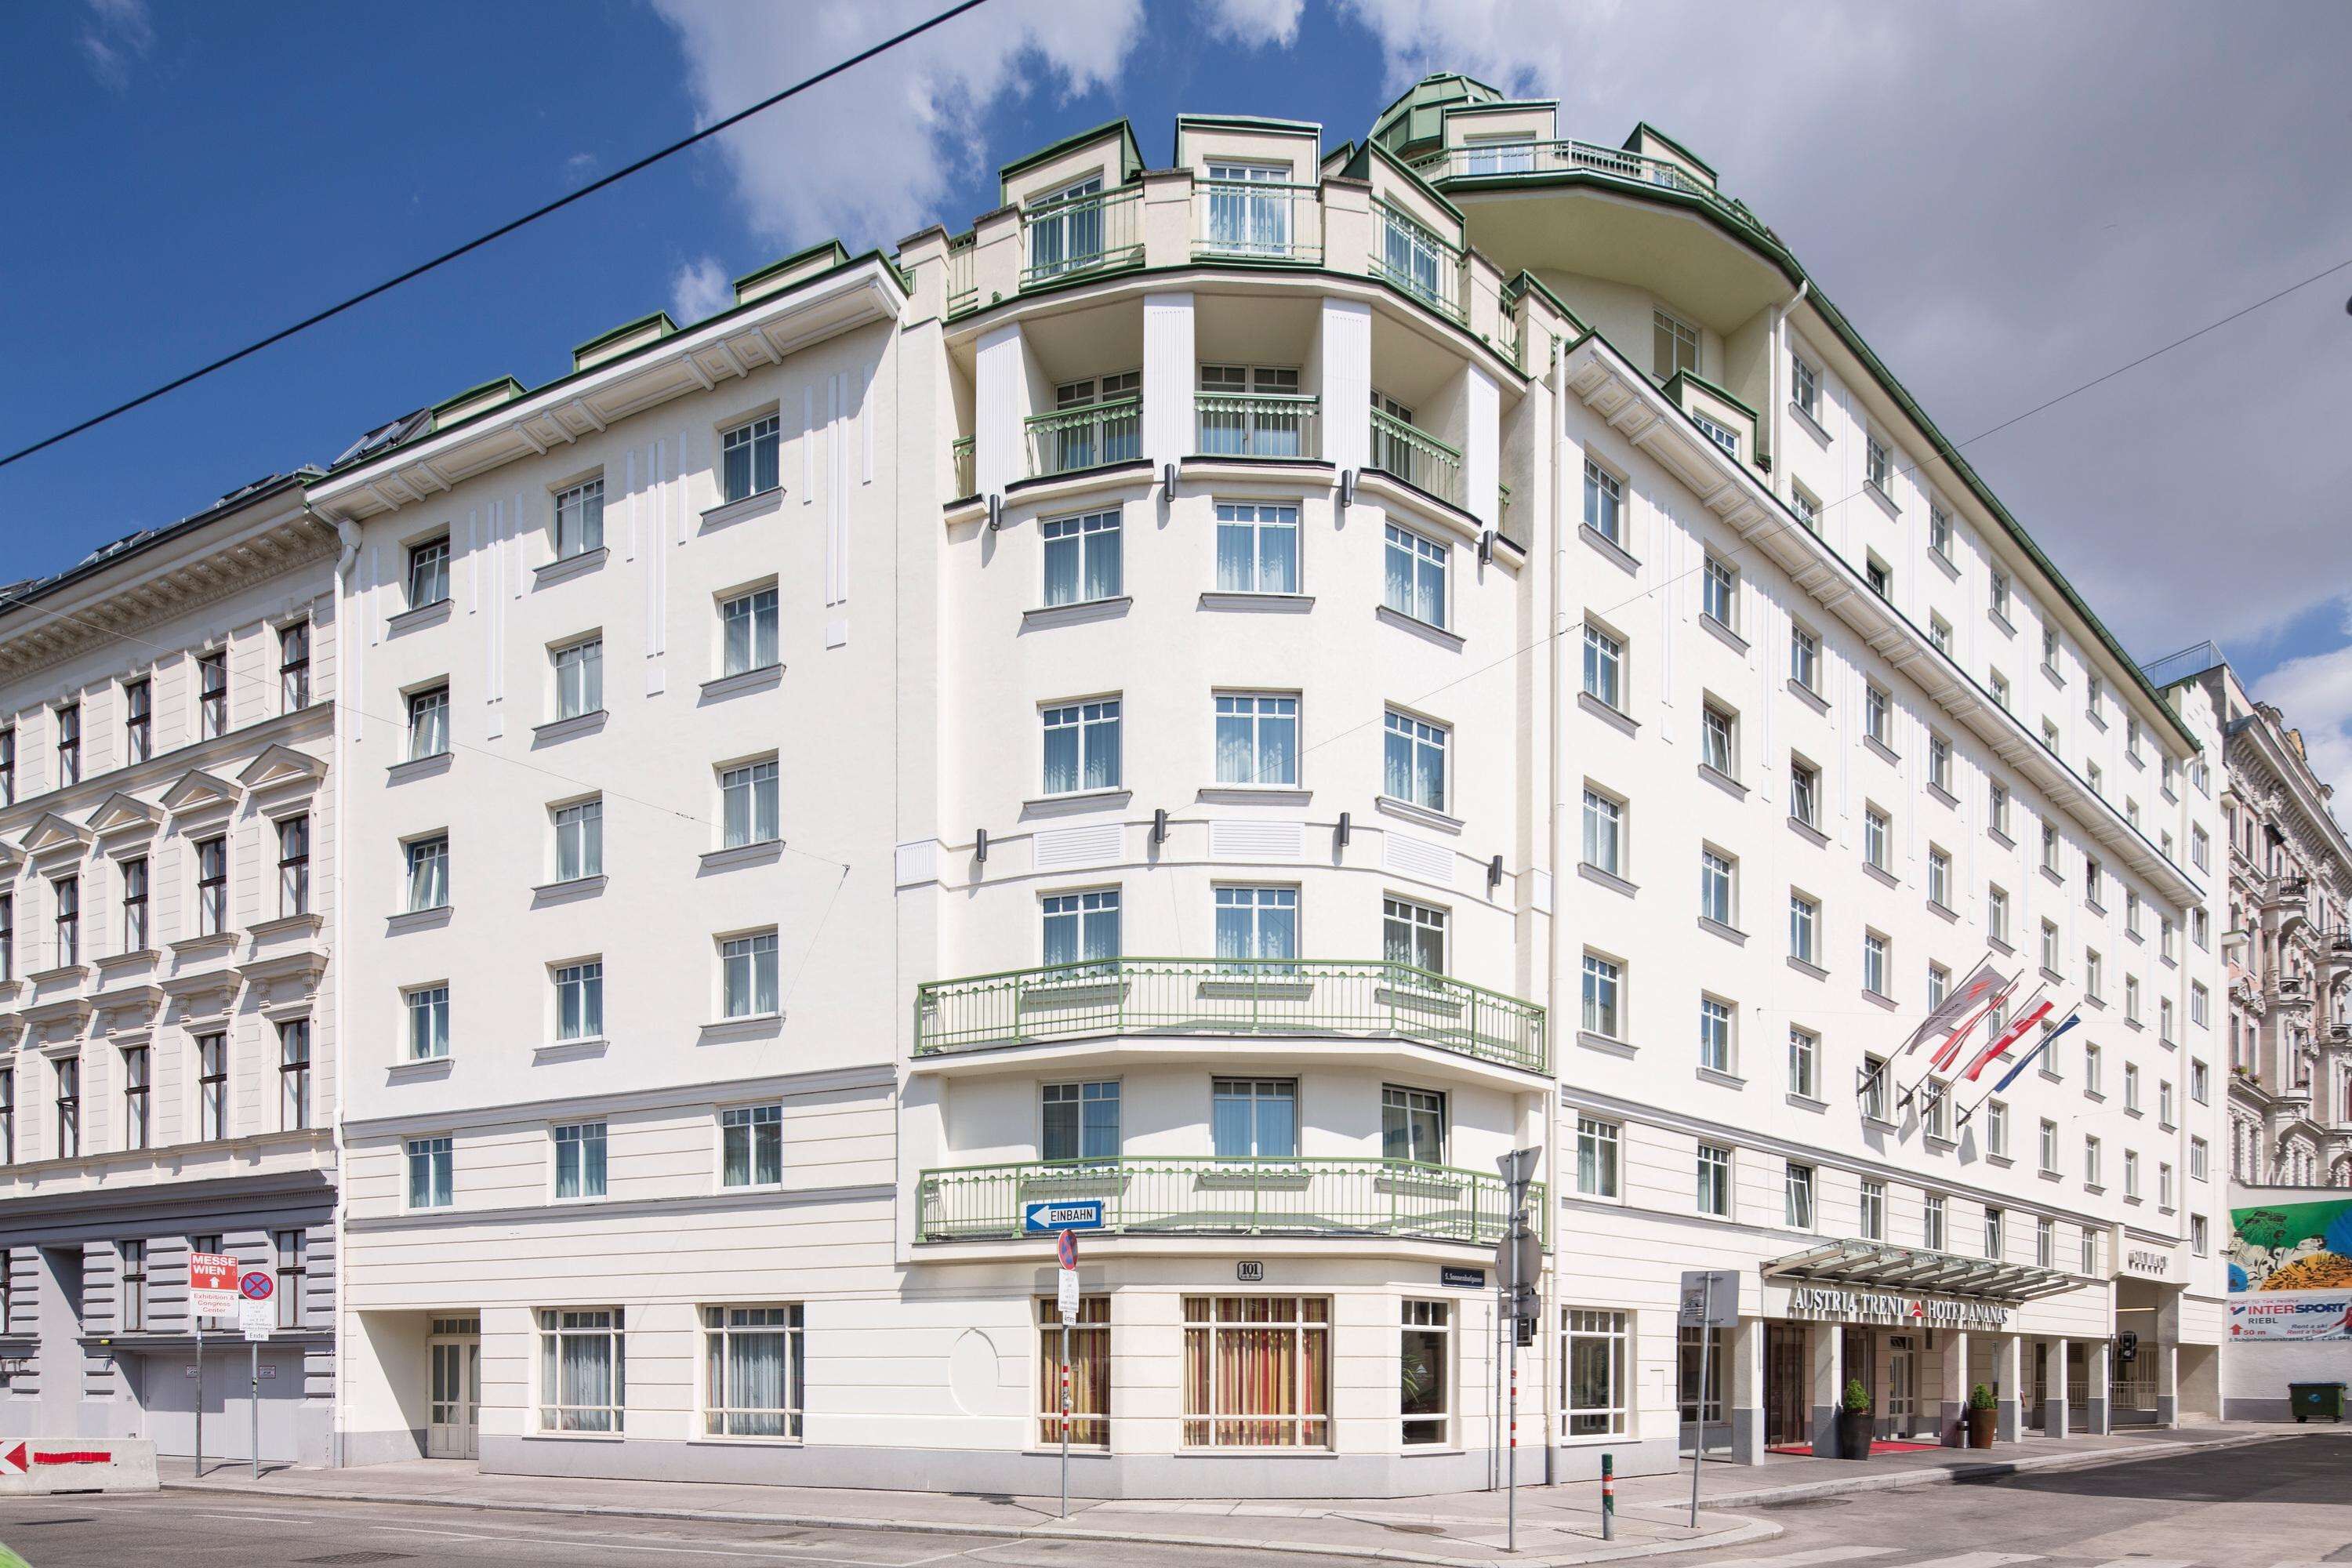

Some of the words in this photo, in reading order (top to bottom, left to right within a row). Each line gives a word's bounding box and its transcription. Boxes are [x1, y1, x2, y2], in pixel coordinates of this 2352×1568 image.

[1051, 1208, 1093, 1221] EINBAHN
[192, 1254, 236, 1267] MESSE
[193, 1265, 226, 1276] WIEN
[1242, 1263, 1258, 1275] 101
[1794, 1287, 1857, 1312] AUSTRIA
[1927, 1299, 1966, 1321] HOTEL
[1969, 1304, 2009, 1324] ANANAS
[2249, 1302, 2346, 1315] INTERSPORT
